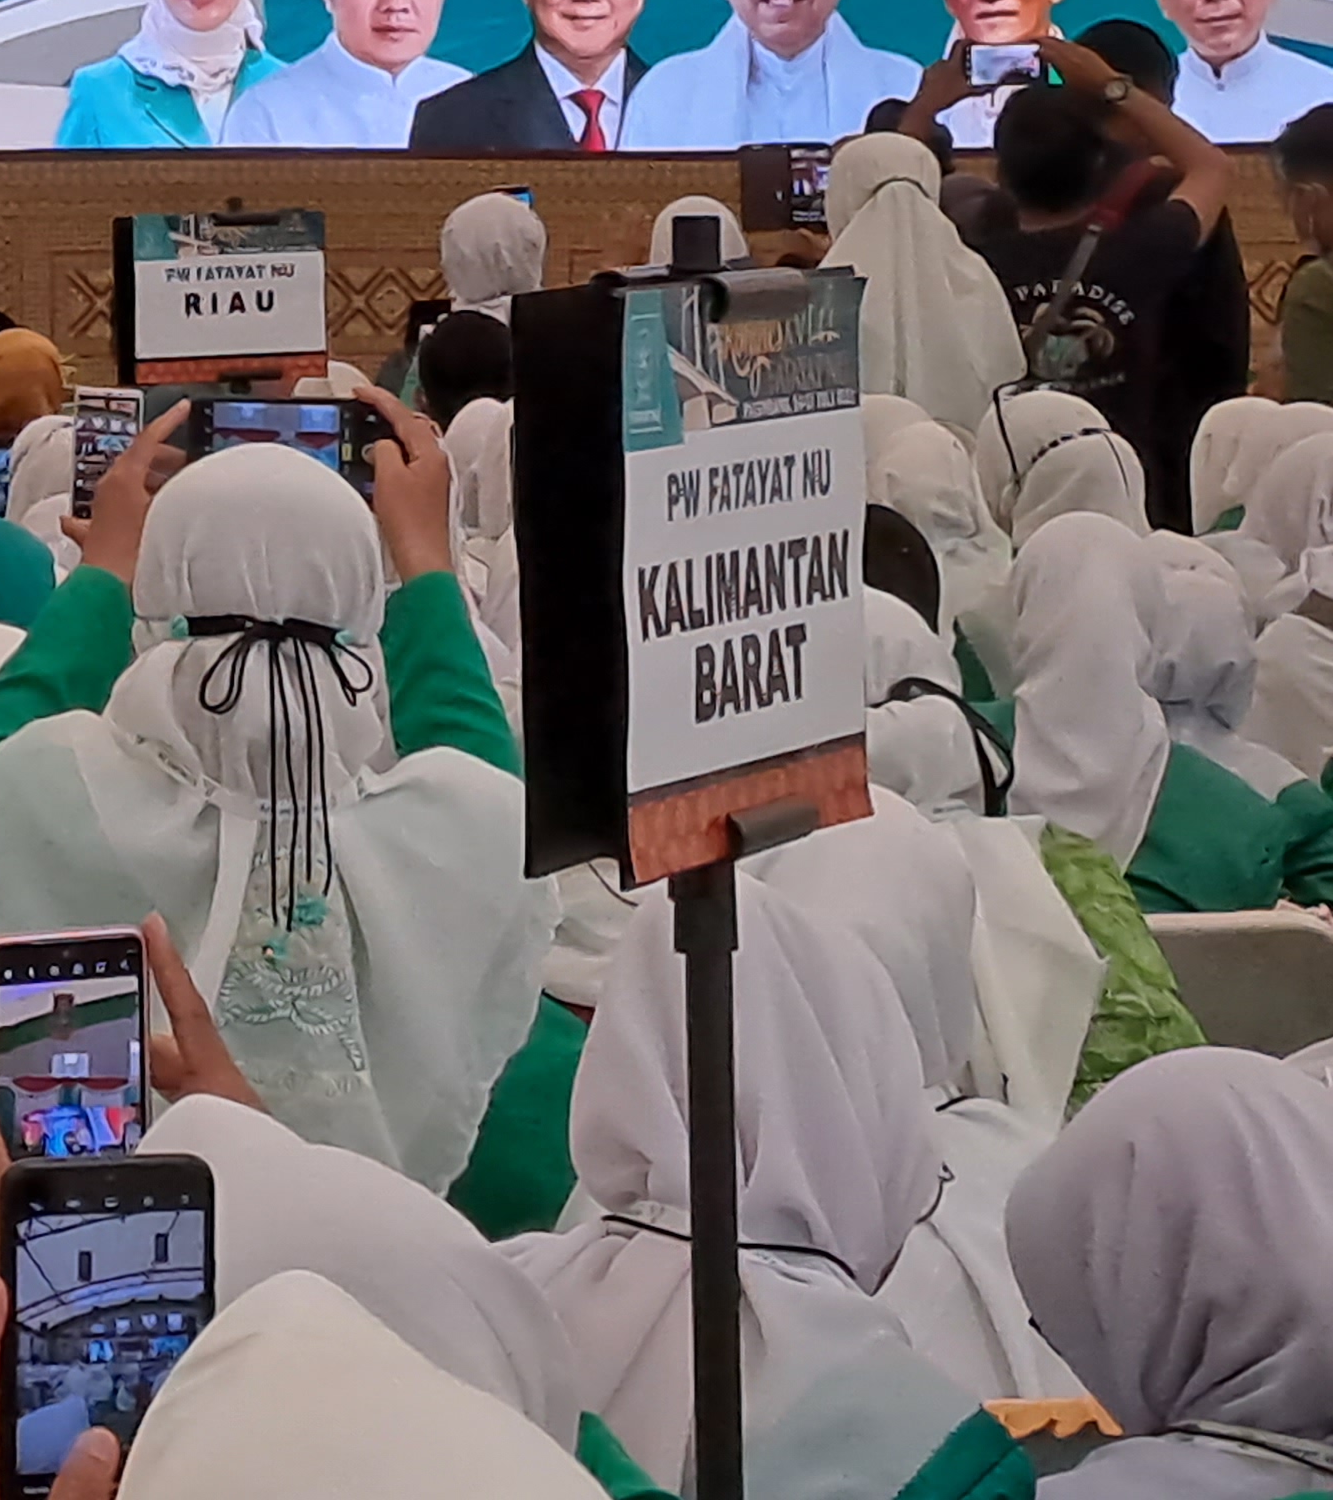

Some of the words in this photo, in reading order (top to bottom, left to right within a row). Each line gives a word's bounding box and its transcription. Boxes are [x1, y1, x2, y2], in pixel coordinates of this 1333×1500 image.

[184, 289, 275, 317] RIAU
[667, 468, 701, 522] PW
[708, 453, 797, 513] FATAYAT
[803, 448, 832, 499] NU
[637, 530, 851, 642] KALIMANTAN
[694, 623, 807, 724] BARAT
